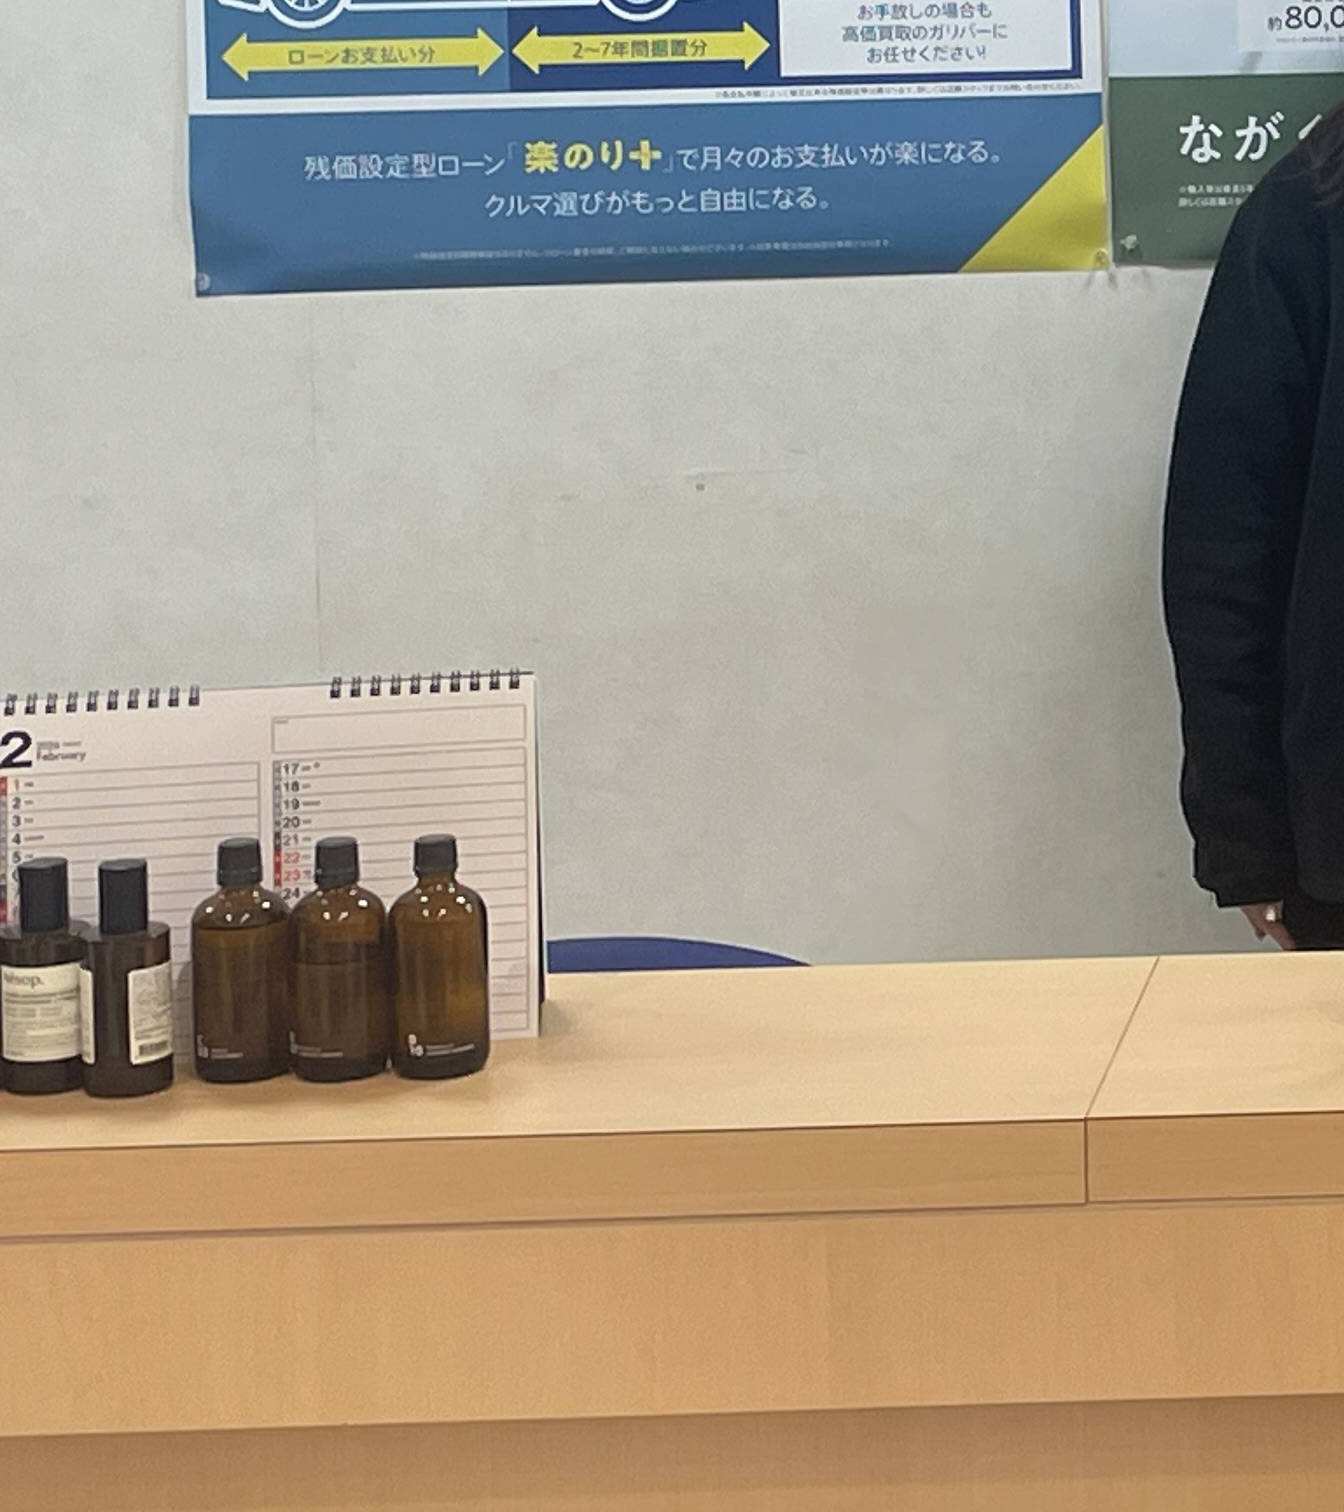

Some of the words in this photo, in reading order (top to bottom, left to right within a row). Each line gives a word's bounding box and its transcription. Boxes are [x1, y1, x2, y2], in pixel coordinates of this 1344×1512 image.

[856, 1, 993, 20] お手放しの場合も
[841, 23, 1008, 43] 高価買取のガリバーに
[288, 45, 435, 66] ローンお支払い分
[482, 185, 834, 220] クルマ選びがもっと自由になる。
[0, 729, 33, 770] 2
[282, 762, 301, 776] 17
[282, 816, 301, 830] 20
